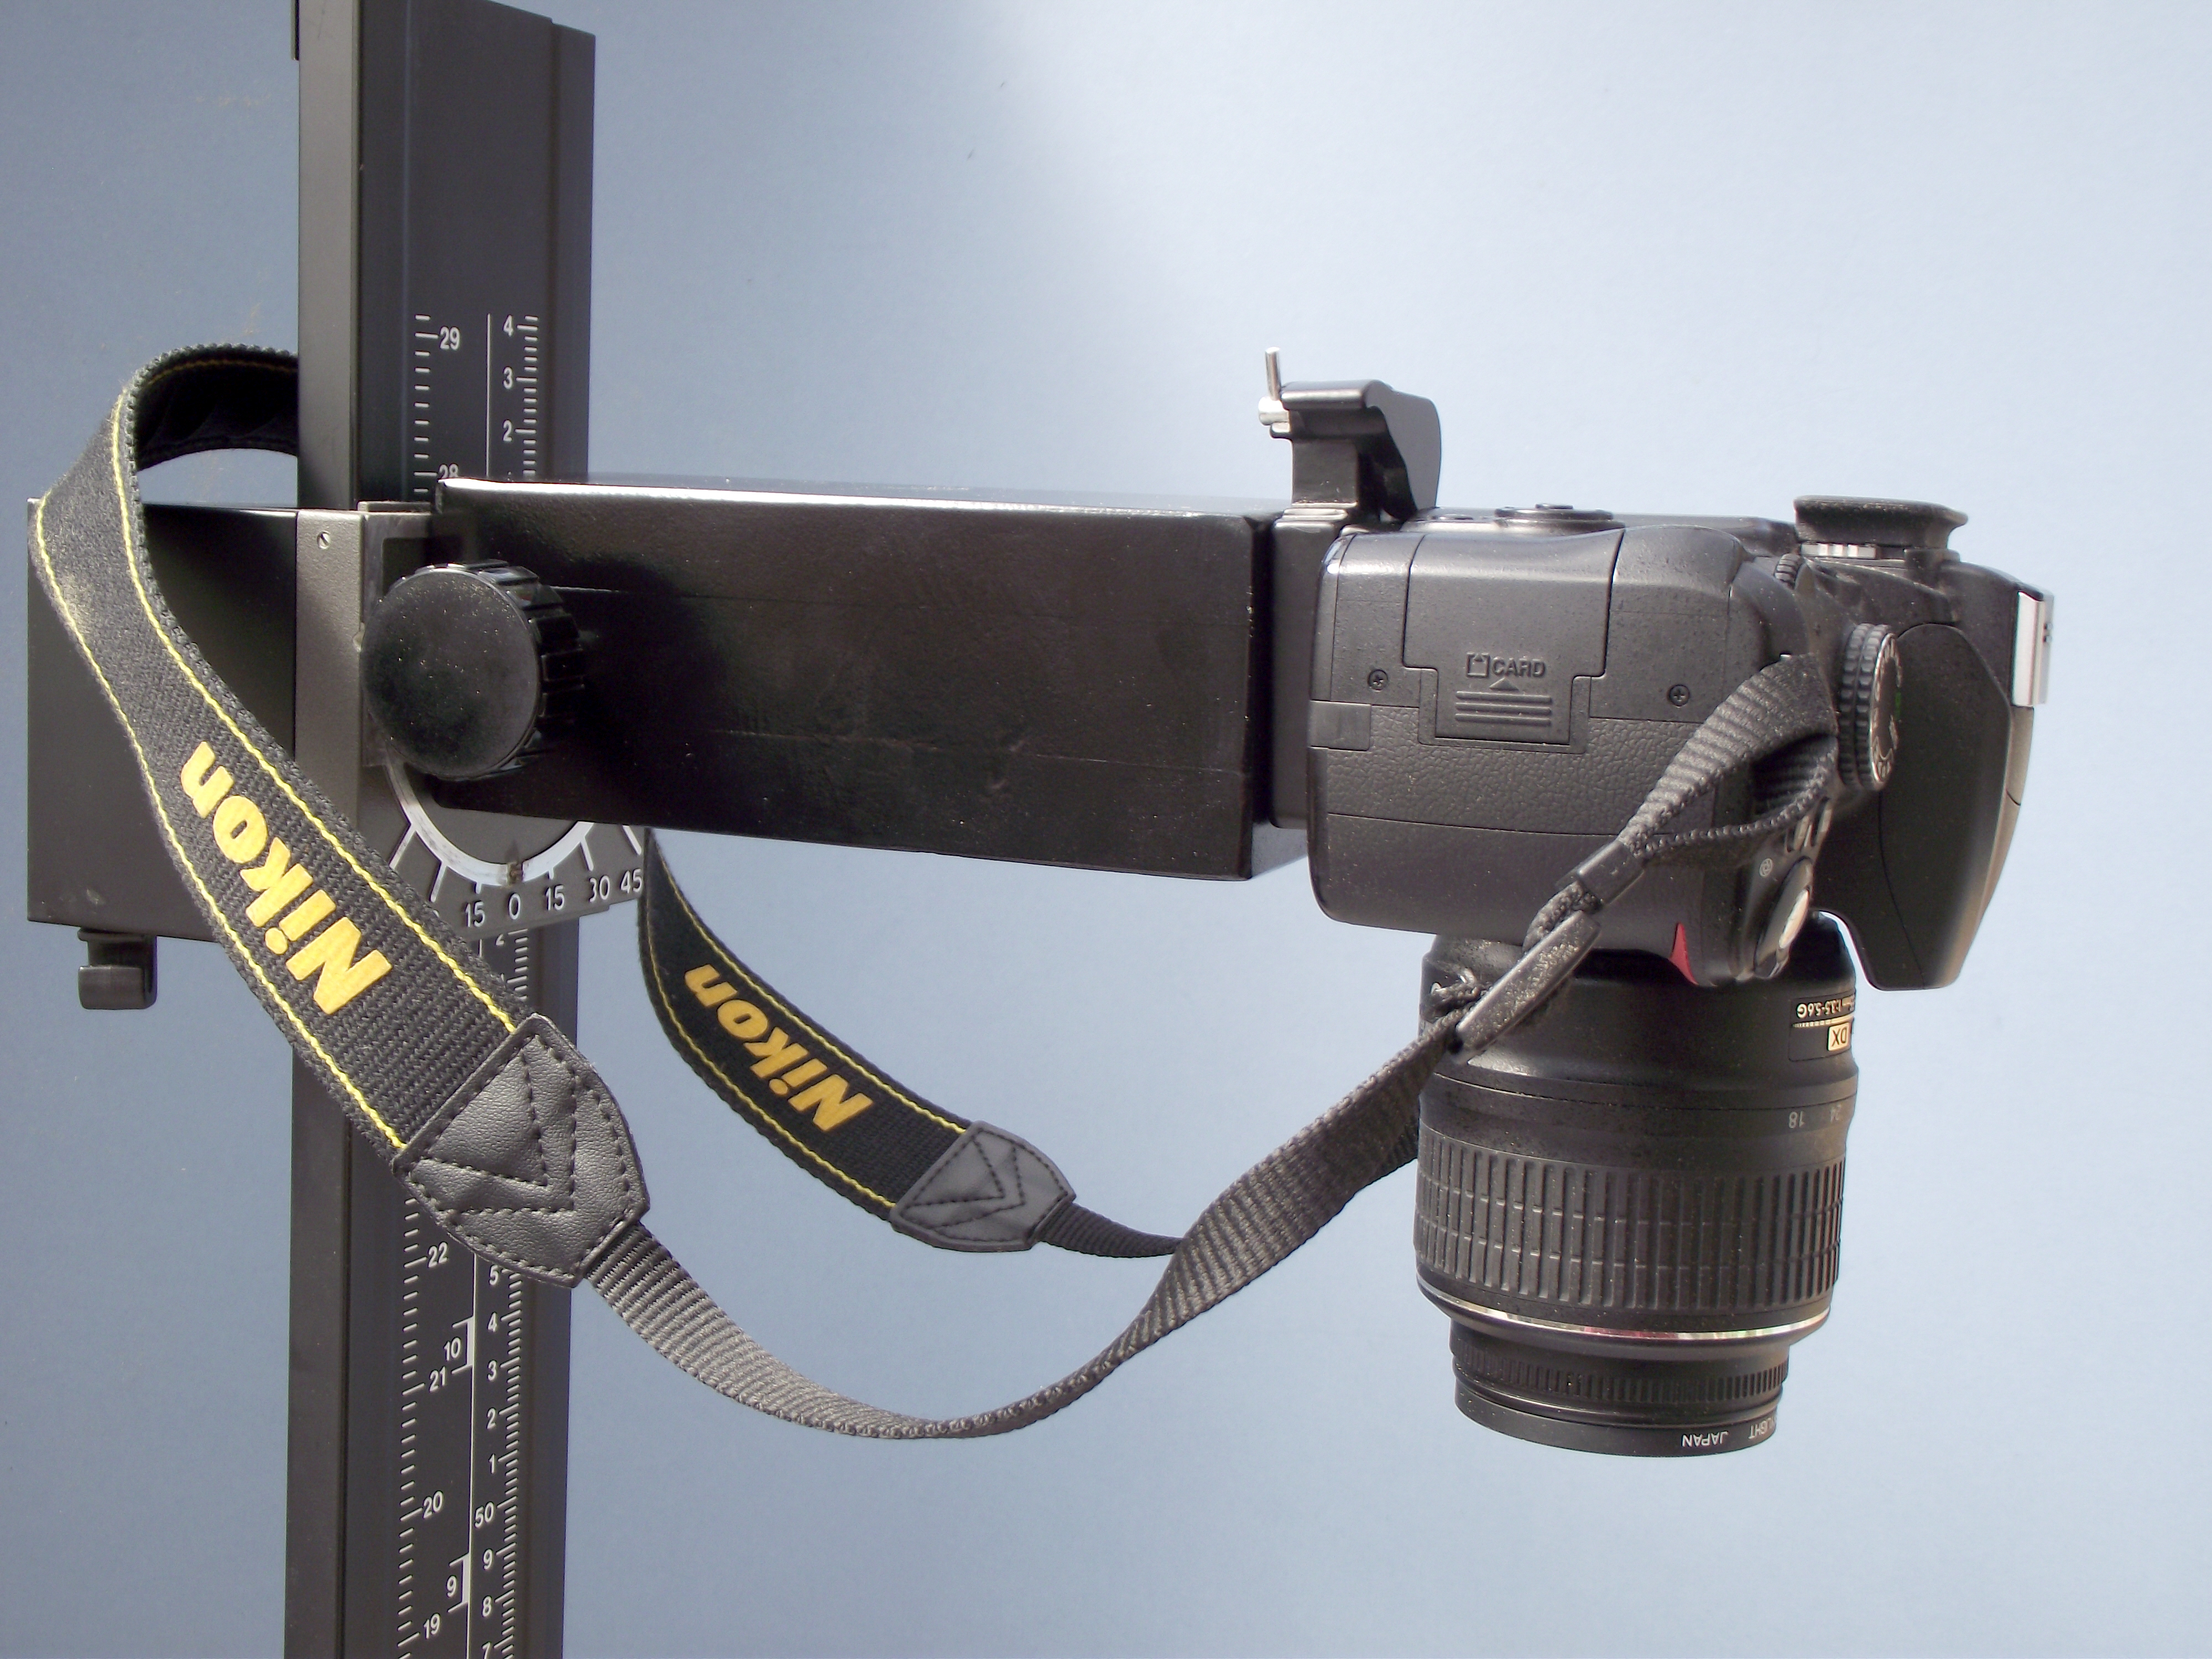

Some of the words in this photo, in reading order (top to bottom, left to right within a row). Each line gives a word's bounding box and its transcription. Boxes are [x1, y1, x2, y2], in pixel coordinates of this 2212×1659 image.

[503, 315, 514, 337] 4
[440, 326, 461, 351] 29
[503, 366, 513, 390] 3
[502, 419, 513, 442] 2
[1493, 656, 1546, 677] CARD
[180, 740, 393, 1015] Nikon
[464, 900, 486, 928] 15
[508, 892, 521, 920] 0
[544, 884, 565, 911] 15
[588, 875, 611, 903] 30
[619, 868, 643, 894] 45
[684, 963, 874, 1132] Nikon
[1831, 1026, 1848, 1047] DX
[1788, 1110, 1804, 1129] 18
[427, 1241, 448, 1269] 22
[489, 1264, 499, 1286] 5
[488, 1312, 498, 1332] 4
[444, 1337, 462, 1361] 10
[429, 1365, 446, 1392] 21
[487, 1359, 497, 1381] 3
[487, 1407, 497, 1430] 2
[1681, 1431, 1729, 1448] JAPAN
[488, 1453, 496, 1474] 1
[422, 1490, 443, 1520] 20
[474, 1501, 494, 1528] 50
[483, 1548, 494, 1571] 9
[446, 1574, 457, 1598] 9
[481, 1595, 493, 1618] 8
[422, 1612, 441, 1639] 19
[482, 1641, 492, 1659] 7
